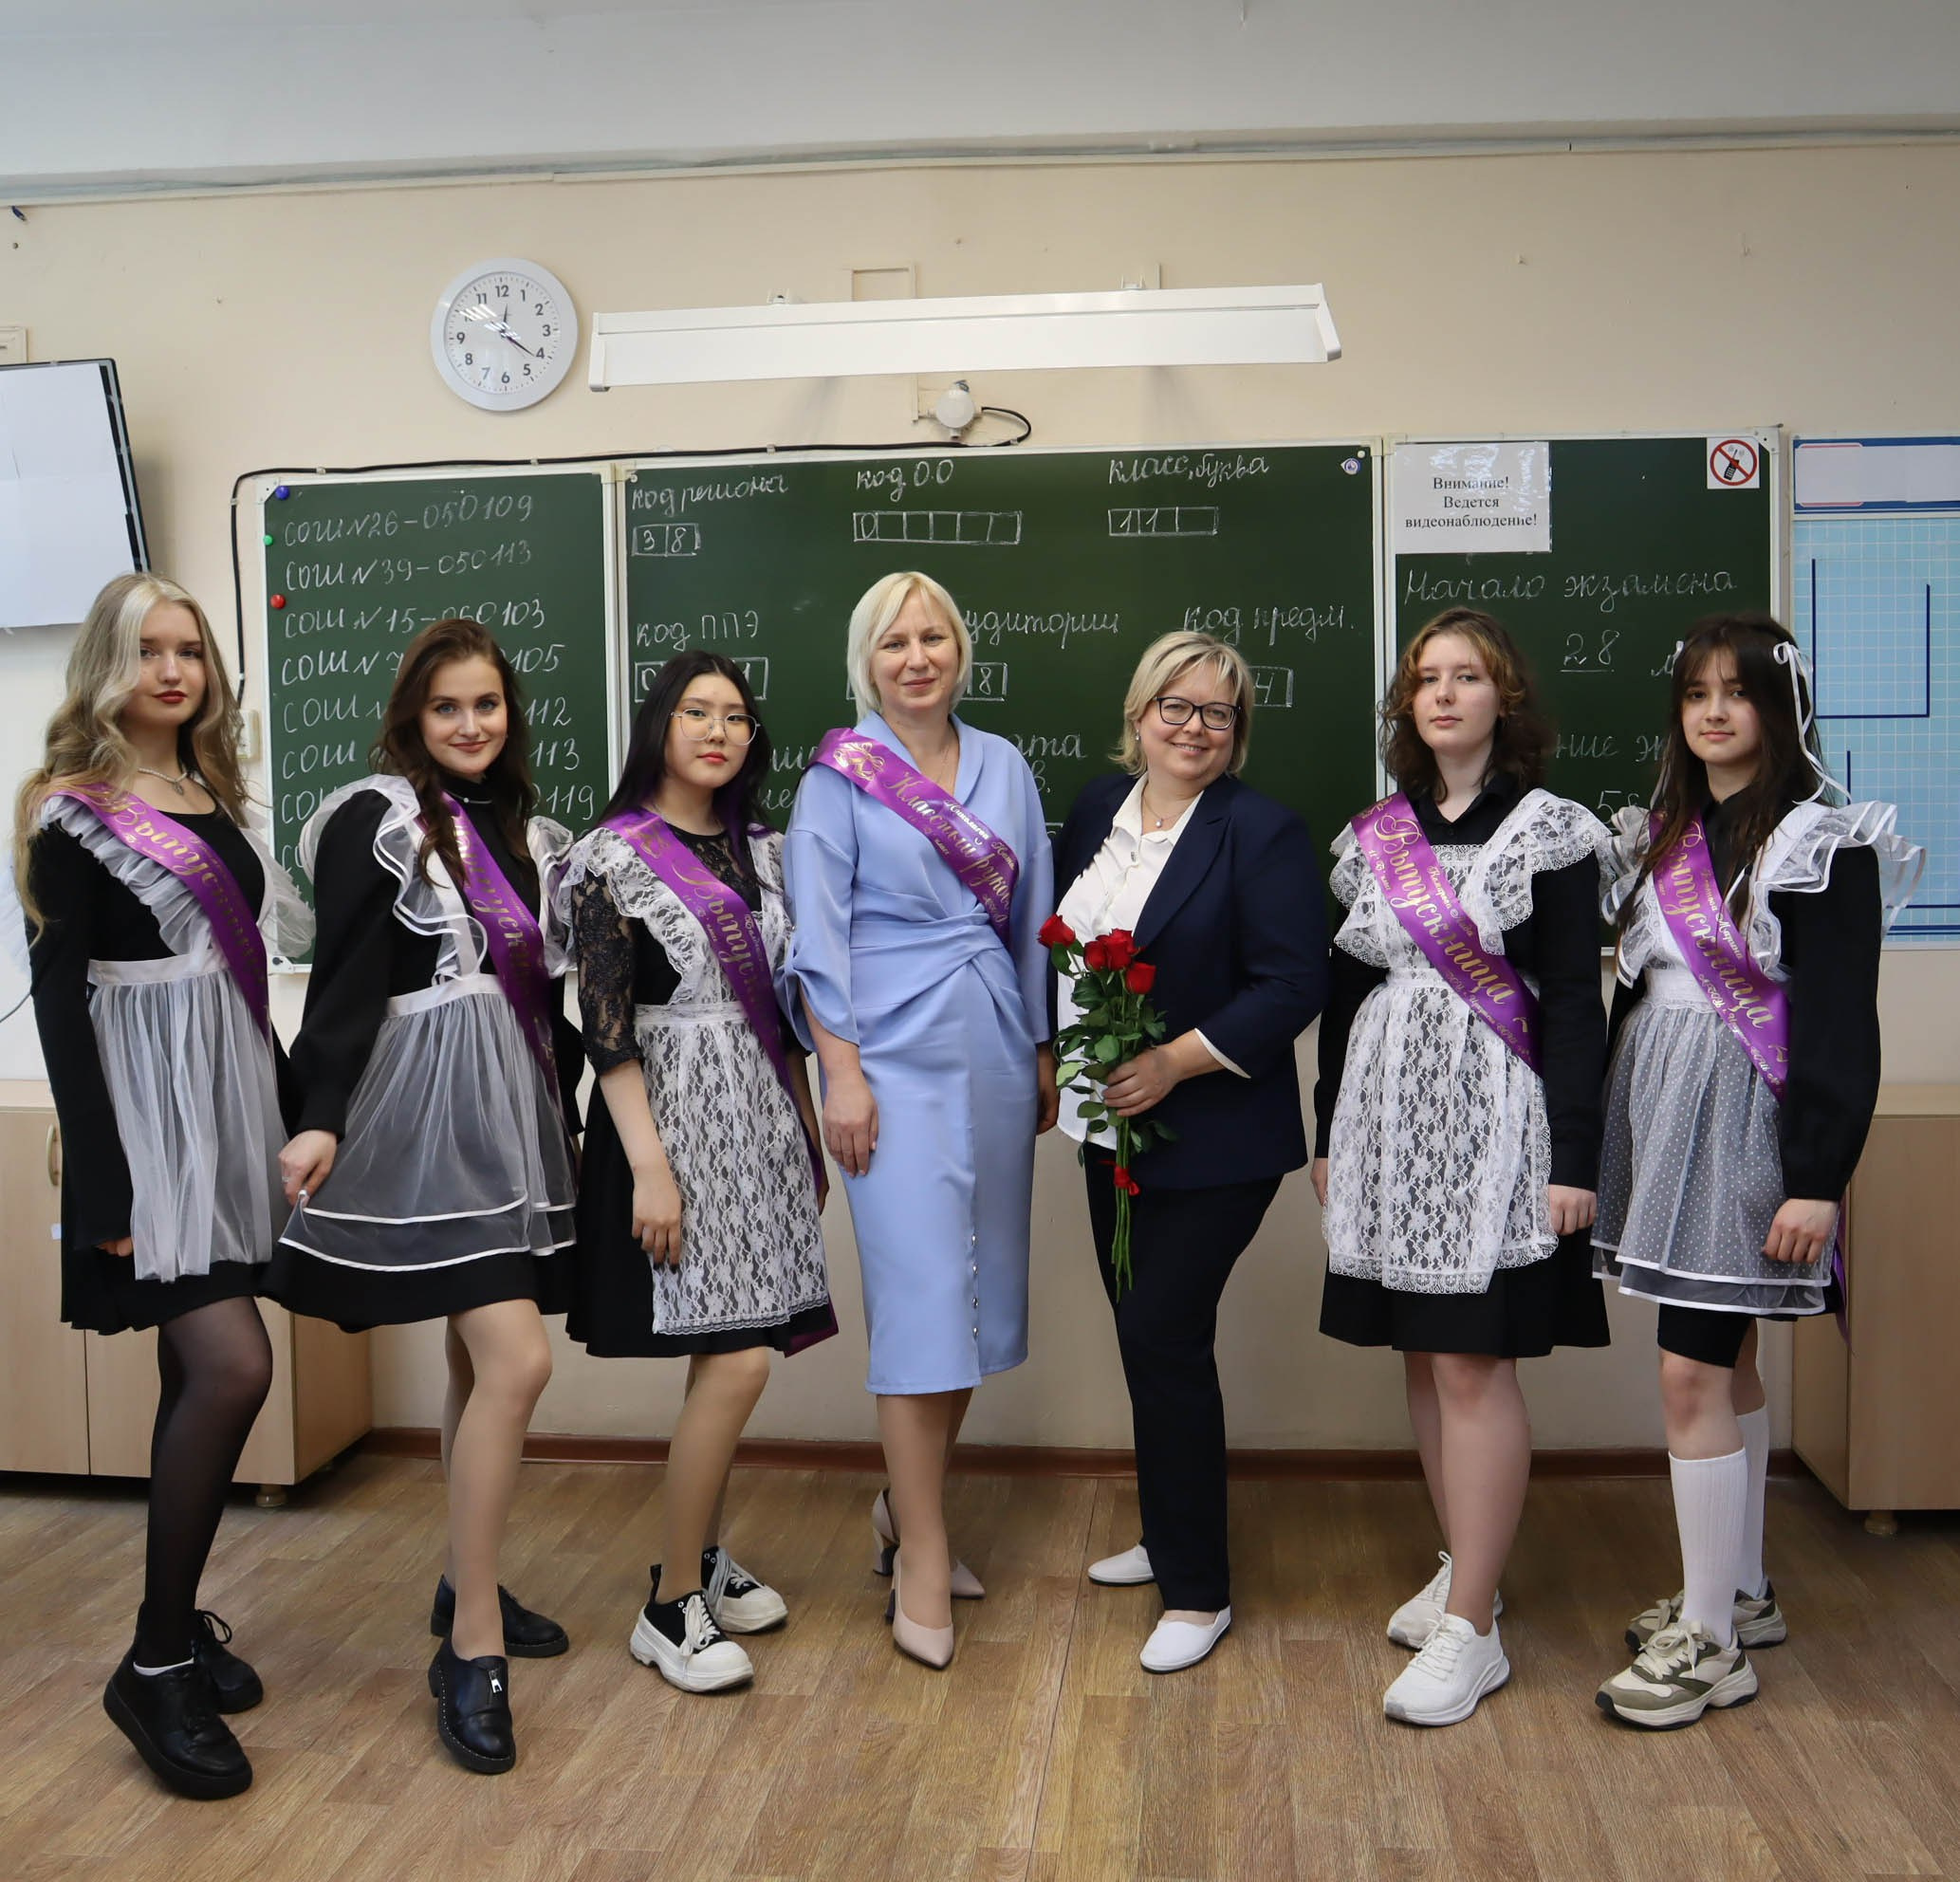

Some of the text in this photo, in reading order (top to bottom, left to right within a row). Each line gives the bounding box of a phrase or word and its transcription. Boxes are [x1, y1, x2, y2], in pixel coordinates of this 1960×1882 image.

[476, 292, 488, 304] 11
[495, 285, 509, 298] 12
[520, 289, 527, 302] 1
[534, 304, 544, 316] 2
[542, 324, 551, 337] 3
[456, 332, 465, 344] 9
[465, 353, 473, 365] 8
[535, 347, 545, 360] 4
[481, 367, 491, 379] 7
[523, 363, 531, 377] 5
[501, 372, 510, 384] 6
[1433, 476, 1509, 489] Внимание!
[1444, 496, 1499, 509] Ведется
[1405, 513, 1537, 528] видеонаблюдение!
[1404, 569, 1547, 606] Начало
[636, 610, 759, 652] код ППЭ
[964, 610, 1120, 650] удитории
[1374, 814, 1517, 1006] Выпускница
